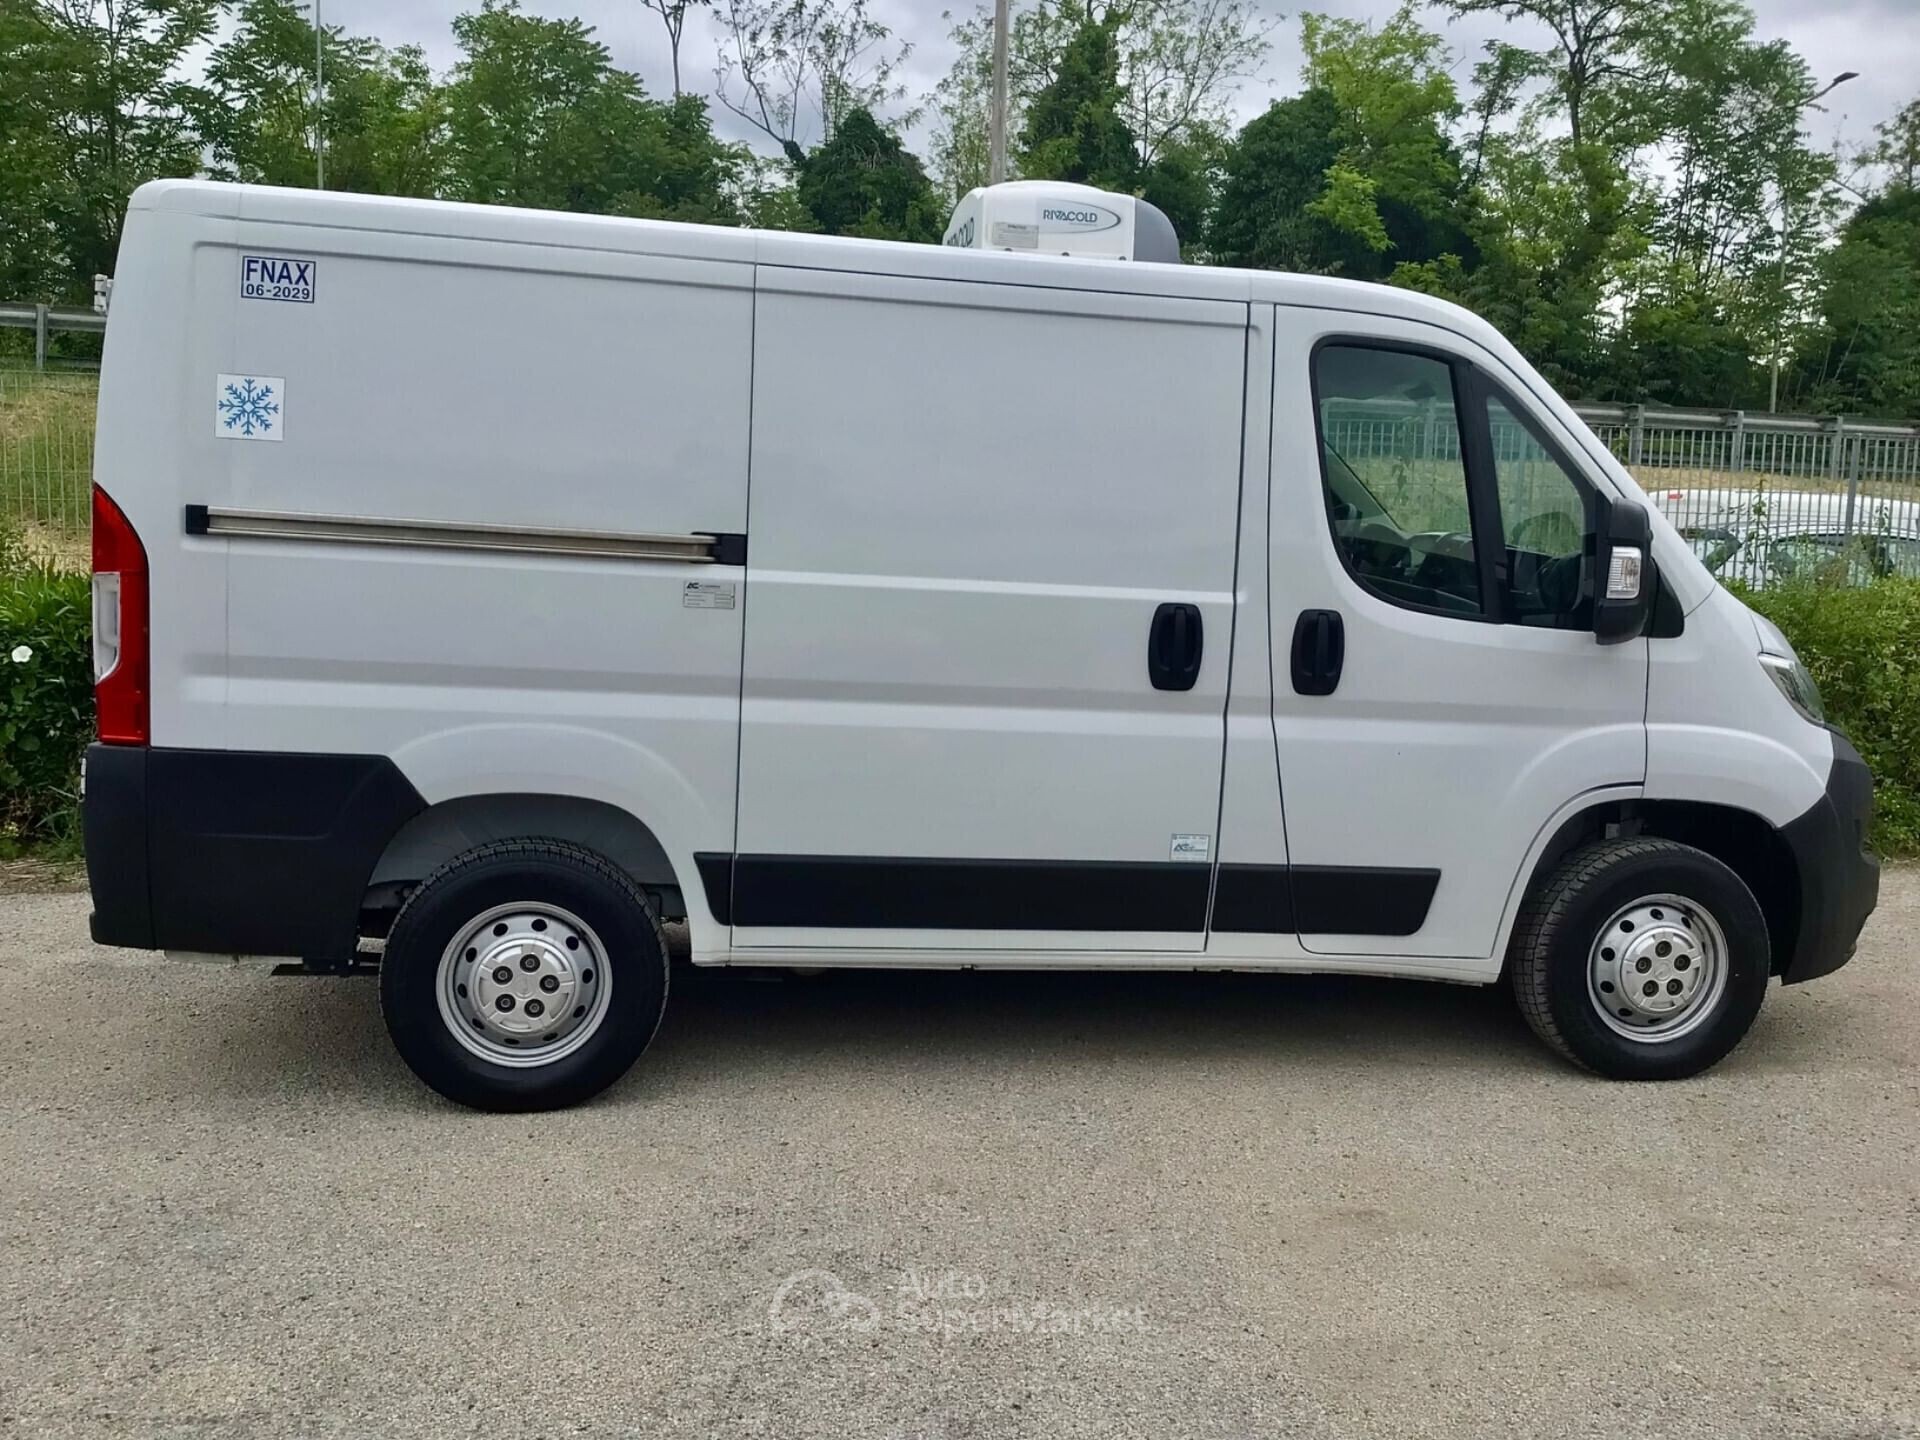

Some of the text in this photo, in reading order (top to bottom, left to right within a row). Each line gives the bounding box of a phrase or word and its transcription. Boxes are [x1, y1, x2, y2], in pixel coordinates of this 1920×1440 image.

[1043, 209, 1098, 223] RIVACOLD
[246, 259, 310, 286] FNAX
[246, 283, 310, 300] 06-2029
